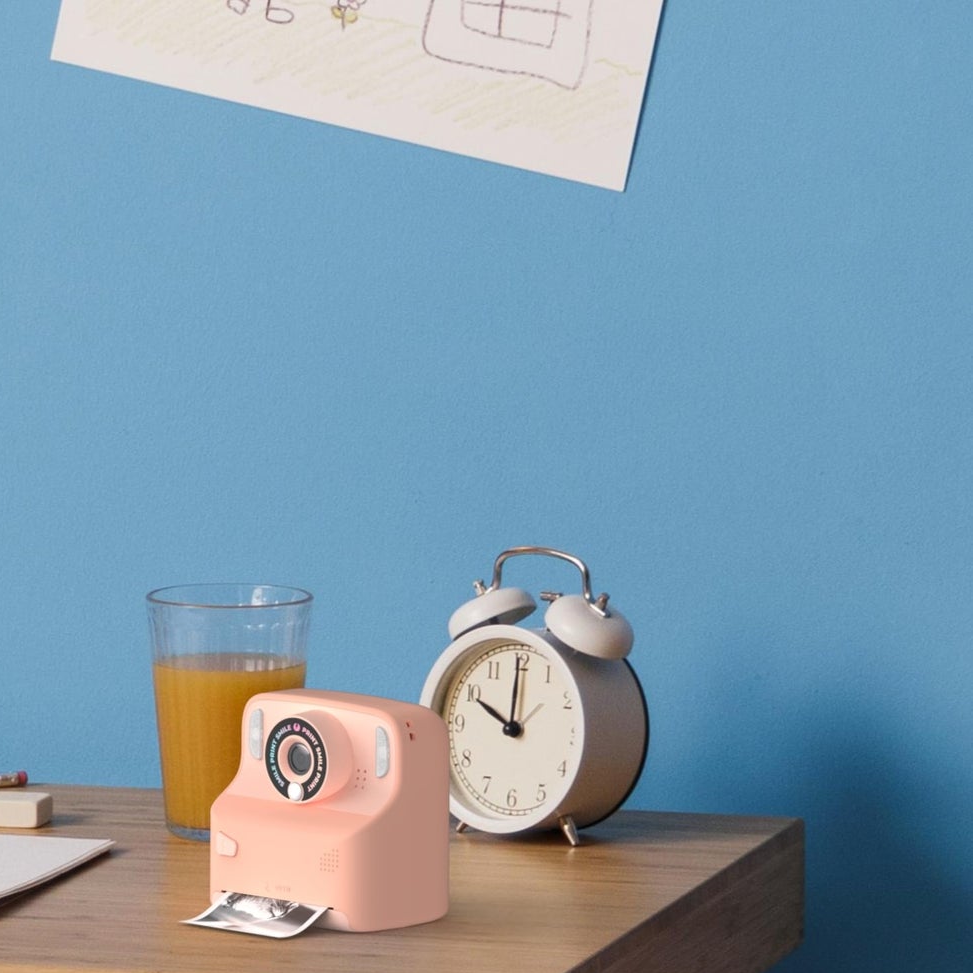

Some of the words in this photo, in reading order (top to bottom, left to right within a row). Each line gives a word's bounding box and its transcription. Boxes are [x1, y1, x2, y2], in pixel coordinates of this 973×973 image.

[487, 662, 500, 679] 11
[514, 652, 530, 671] 12
[544, 665, 551, 683] 1
[467, 684, 481, 702] 10
[275, 724, 292, 739] SMILE
[455, 714, 465, 733] 9
[301, 727, 318, 746] PRINT
[461, 749, 471, 767] 8
[271, 765, 285, 787] SMILE
[557, 761, 566, 778] 4
[307, 772, 321, 792] PRINT
[483, 776, 492, 794] 7
[507, 789, 517, 807] 6
[536, 784, 546, 802] 5
